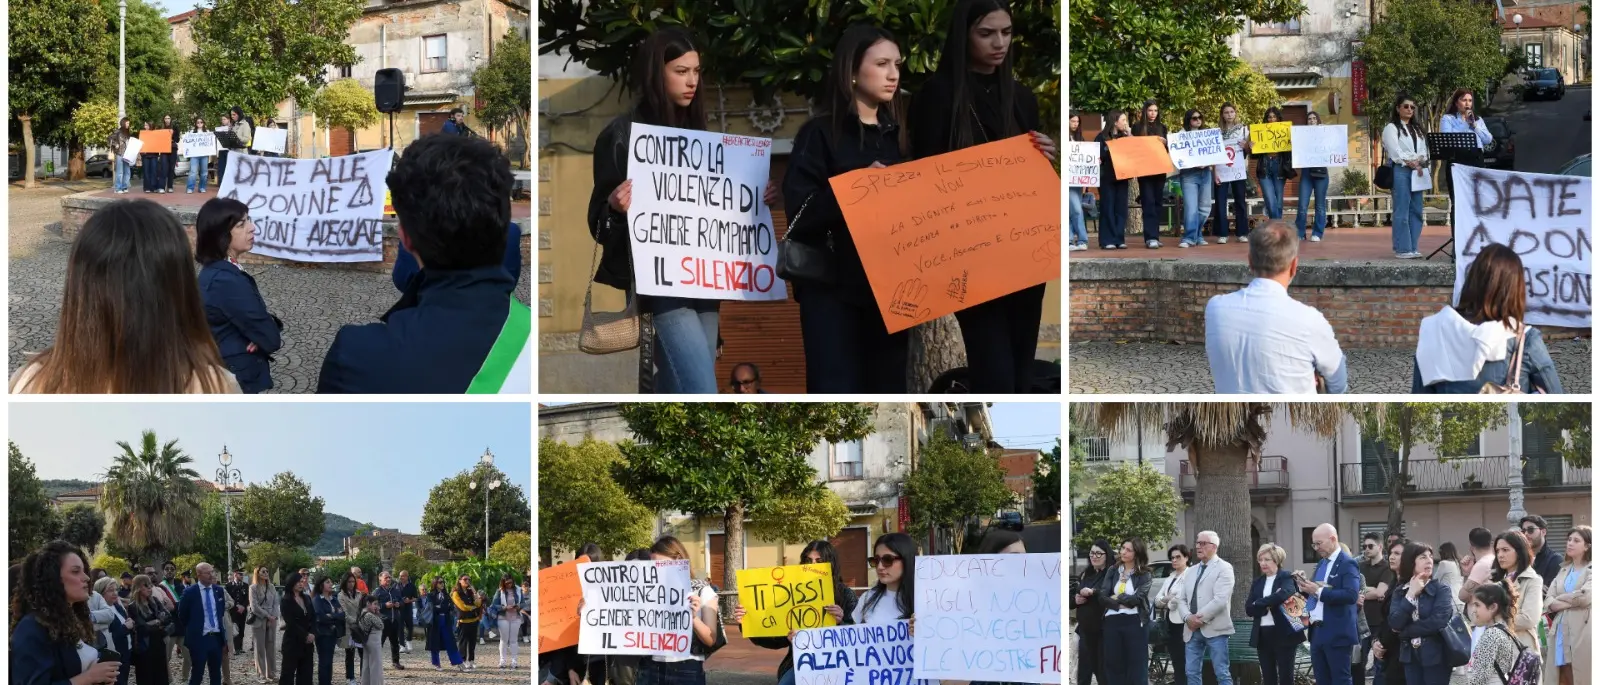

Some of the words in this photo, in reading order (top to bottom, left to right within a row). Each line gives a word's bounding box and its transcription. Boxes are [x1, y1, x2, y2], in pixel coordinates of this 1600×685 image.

[1071, 143, 1080, 153] LA
[1170, 140, 1191, 150] ALZA
[1192, 139, 1203, 147] LA
[1253, 130, 1263, 143] TI
[633, 134, 703, 170] CONTRO
[708, 142, 724, 174] LA
[934, 161, 952, 176] IL
[955, 155, 1027, 173] SILENZIO
[1086, 155, 1096, 165] DI
[234, 155, 296, 186] DATE
[309, 155, 367, 183] ALLE
[652, 171, 733, 210] VIOLENZA
[740, 183, 759, 216] DI
[934, 176, 964, 195] NON
[1472, 172, 1581, 219] DATE
[247, 186, 342, 215] DONNE
[254, 216, 298, 246] SIONI
[307, 217, 382, 248] ADEGUATE
[633, 212, 693, 246] GENERE
[697, 216, 771, 256] ROMPIAMO
[889, 221, 905, 236] LA
[995, 234, 1003, 243] E
[893, 229, 940, 256] VIOLENZA
[654, 256, 673, 287] IL
[680, 256, 775, 293] SILENZIO
[584, 565, 639, 584] CONTRO
[643, 565, 659, 584] LA
[916, 557, 1005, 580] EDUCATE
[1022, 559, 1027, 577] I
[601, 585, 666, 605] VIOLENZA
[669, 587, 685, 606] DI
[744, 583, 768, 611] TI
[773, 578, 824, 609] DISSI
[990, 588, 1061, 615] NON
[586, 609, 634, 627] GENERE
[638, 609, 691, 631] ROMPIAMO
[761, 615, 777, 629] CA
[921, 614, 1061, 641] SORVEGLIA
[602, 632, 617, 649] IL
[623, 631, 689, 653] SILENZIO
[794, 627, 857, 650] QUANDO
[857, 625, 884, 645] UNA
[797, 650, 850, 671] ALZA
[855, 646, 881, 667] LA
[882, 644, 914, 666] VOC
[921, 646, 952, 672] LE
[962, 649, 1037, 672] VOSTRE
